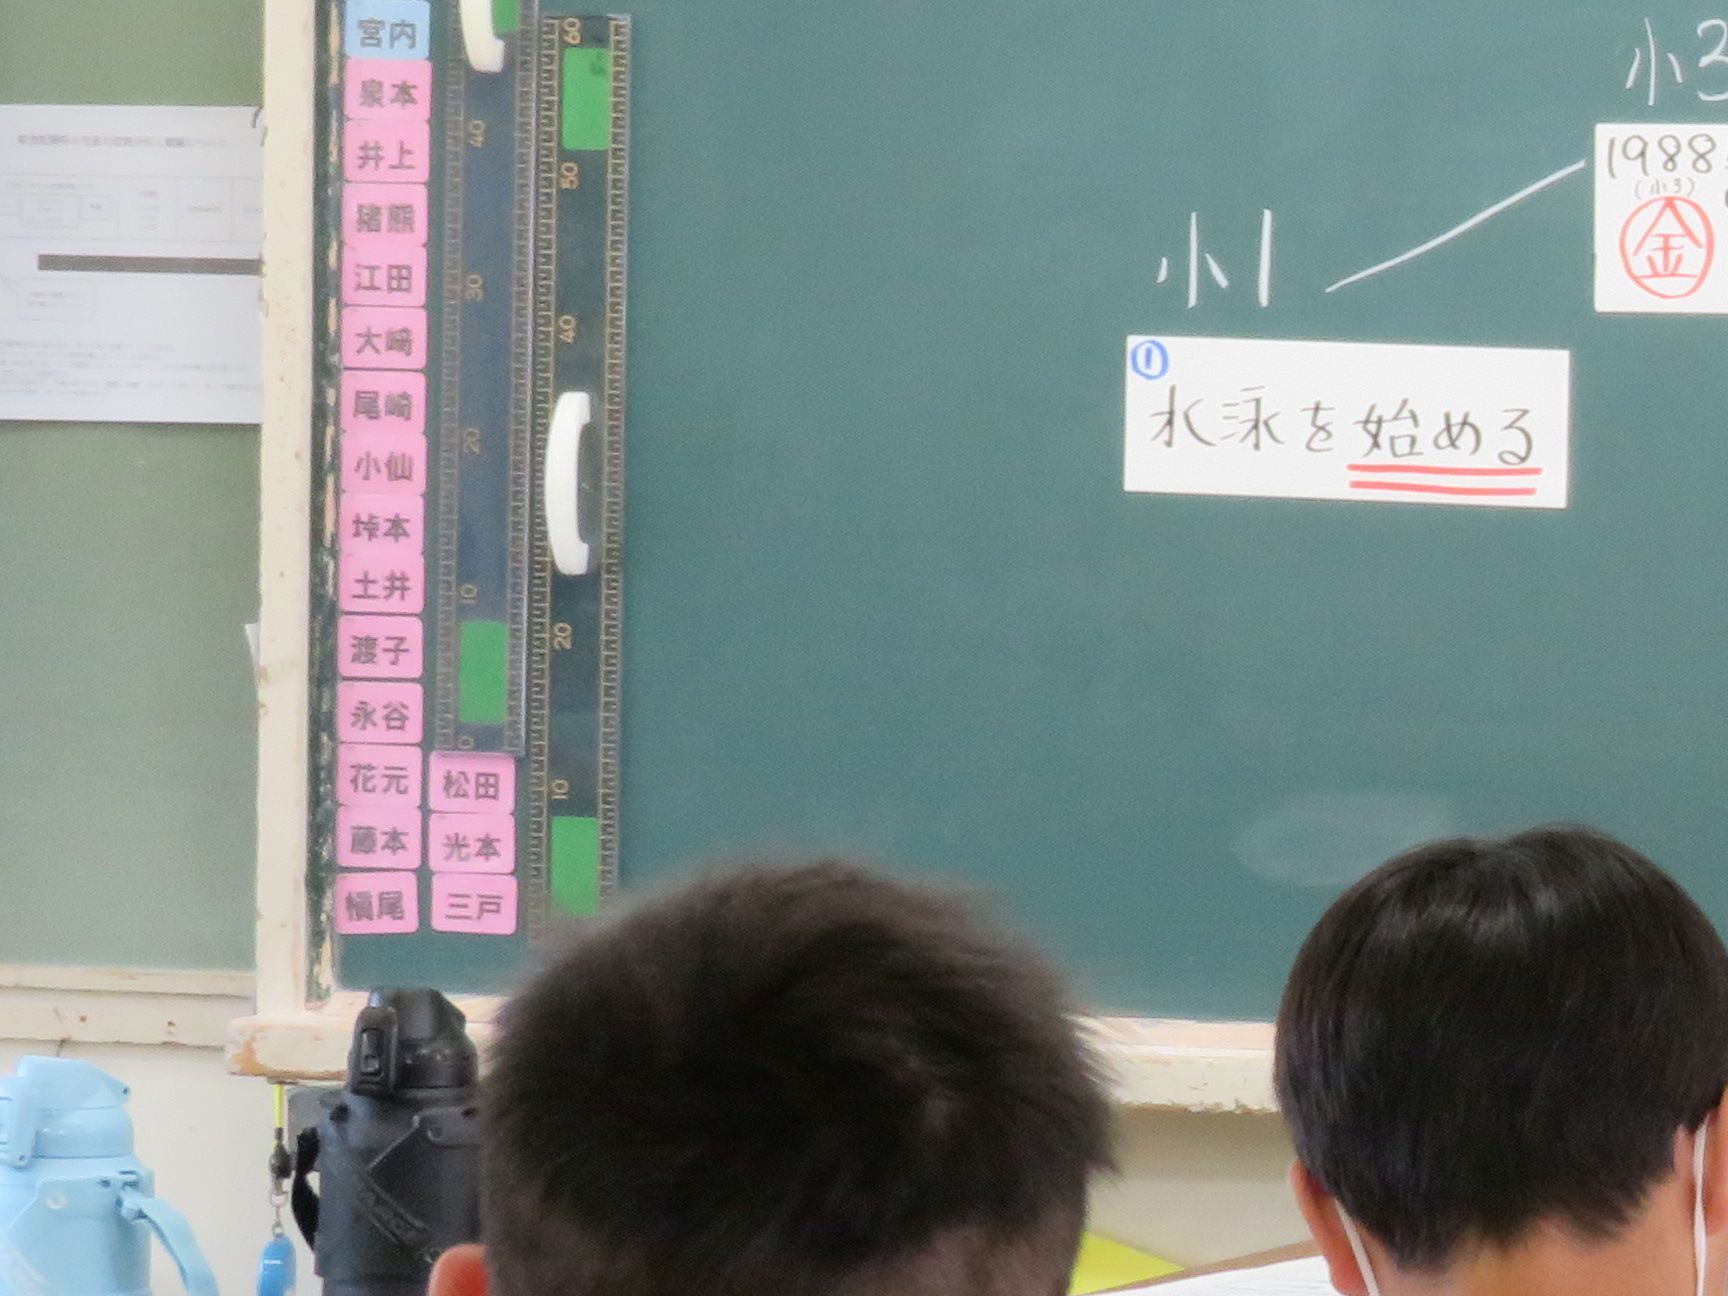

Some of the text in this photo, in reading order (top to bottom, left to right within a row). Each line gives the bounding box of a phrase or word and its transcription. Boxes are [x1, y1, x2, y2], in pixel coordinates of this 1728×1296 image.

[356, 19, 417, 49] 宮内
[357, 140, 416, 171] 井上
[560, 162, 580, 190] 50
[355, 263, 413, 293] 江田
[1149, 385, 1534, 465] 水泳を始める
[354, 451, 414, 481] 小仙
[352, 572, 411, 601] 土井
[553, 622, 572, 650] 20
[350, 700, 410, 732] 永谷
[350, 764, 409, 795] 花元
[443, 770, 501, 801] 松田
[552, 779, 569, 800] 10
[350, 825, 408, 856] 藤本
[443, 833, 501, 863] 光本
[445, 893, 503, 921] 三戸
